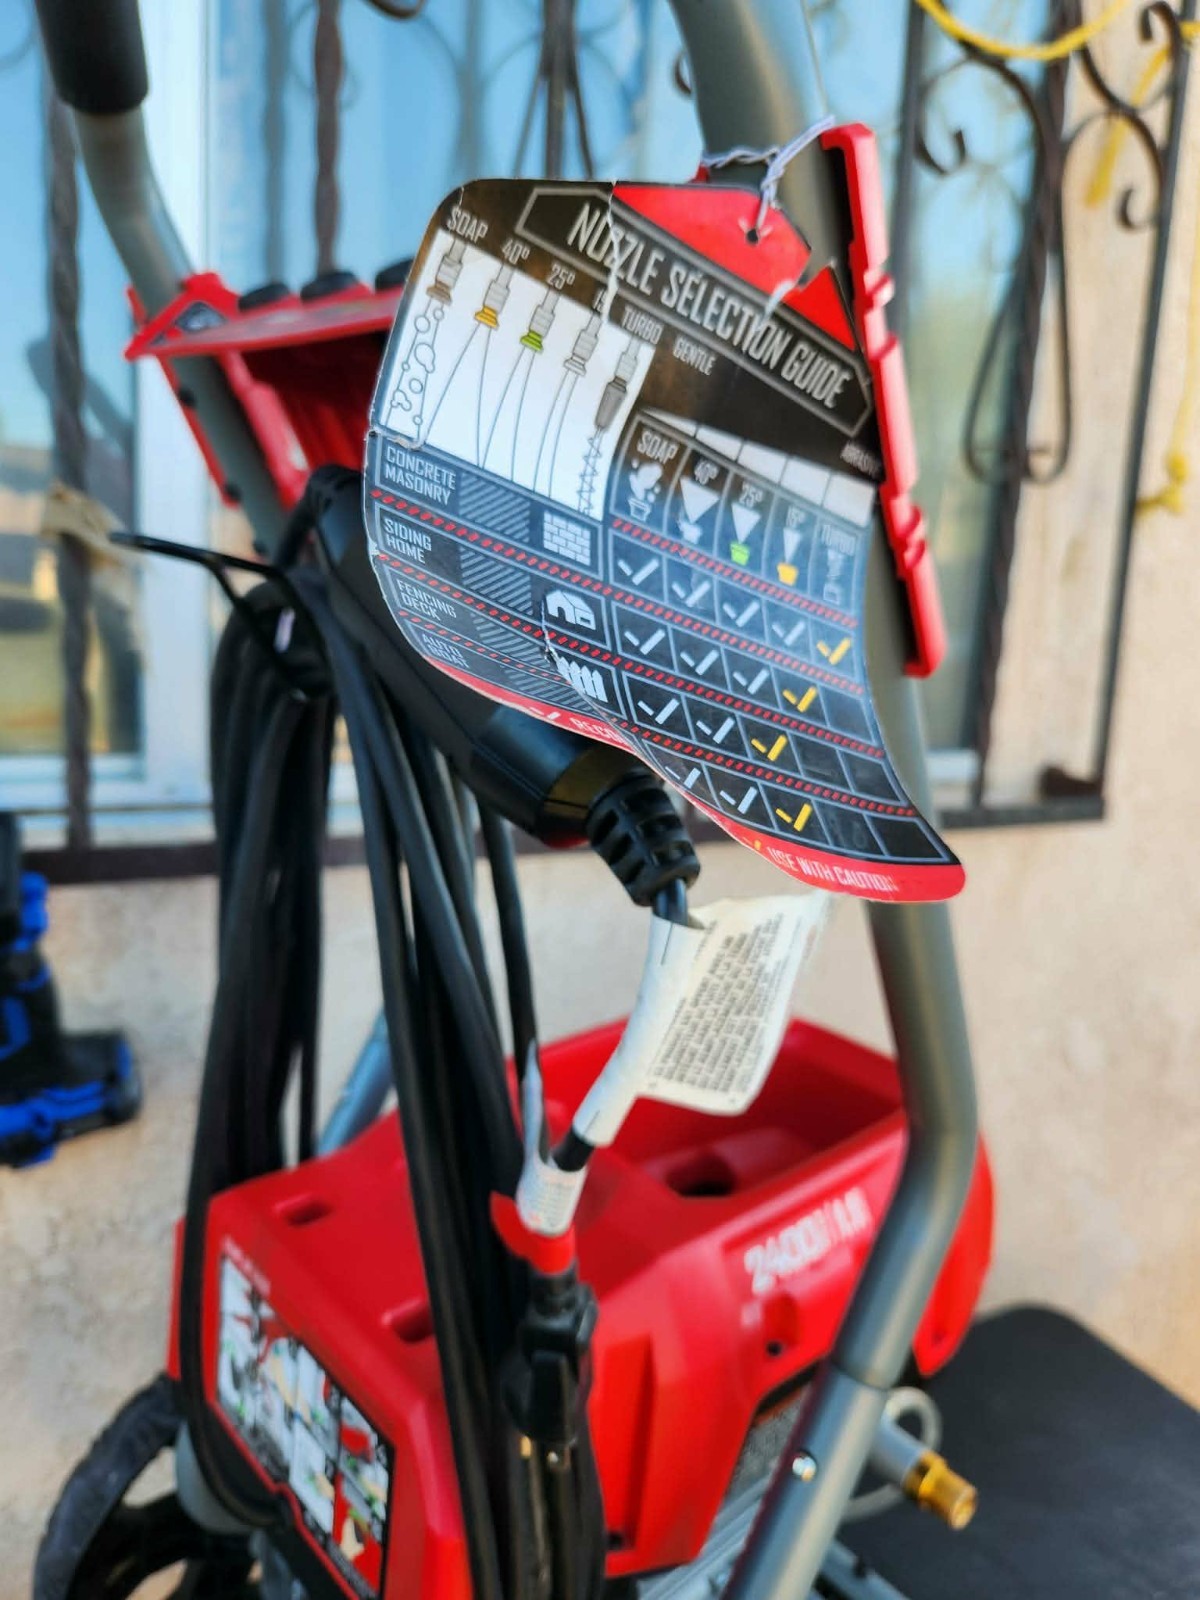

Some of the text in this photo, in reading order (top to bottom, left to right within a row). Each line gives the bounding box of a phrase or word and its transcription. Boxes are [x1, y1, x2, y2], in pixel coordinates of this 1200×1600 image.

[446, 206, 489, 244] SOAP
[621, 303, 664, 345] TURBO
[567, 203, 851, 409] NOZZLE SELECTION GUIDE
[672, 335, 717, 377] GENTLE
[385, 445, 457, 491] CONCRETE
[636, 431, 679, 465] SOAP
[384, 464, 452, 505] MASONRY
[383, 517, 432, 552] SIDING
[386, 533, 427, 564] HOME
[396, 578, 457, 618] FENCING
[400, 592, 441, 621] DECK
[766, 846, 899, 892] USE WITH CAUTION
